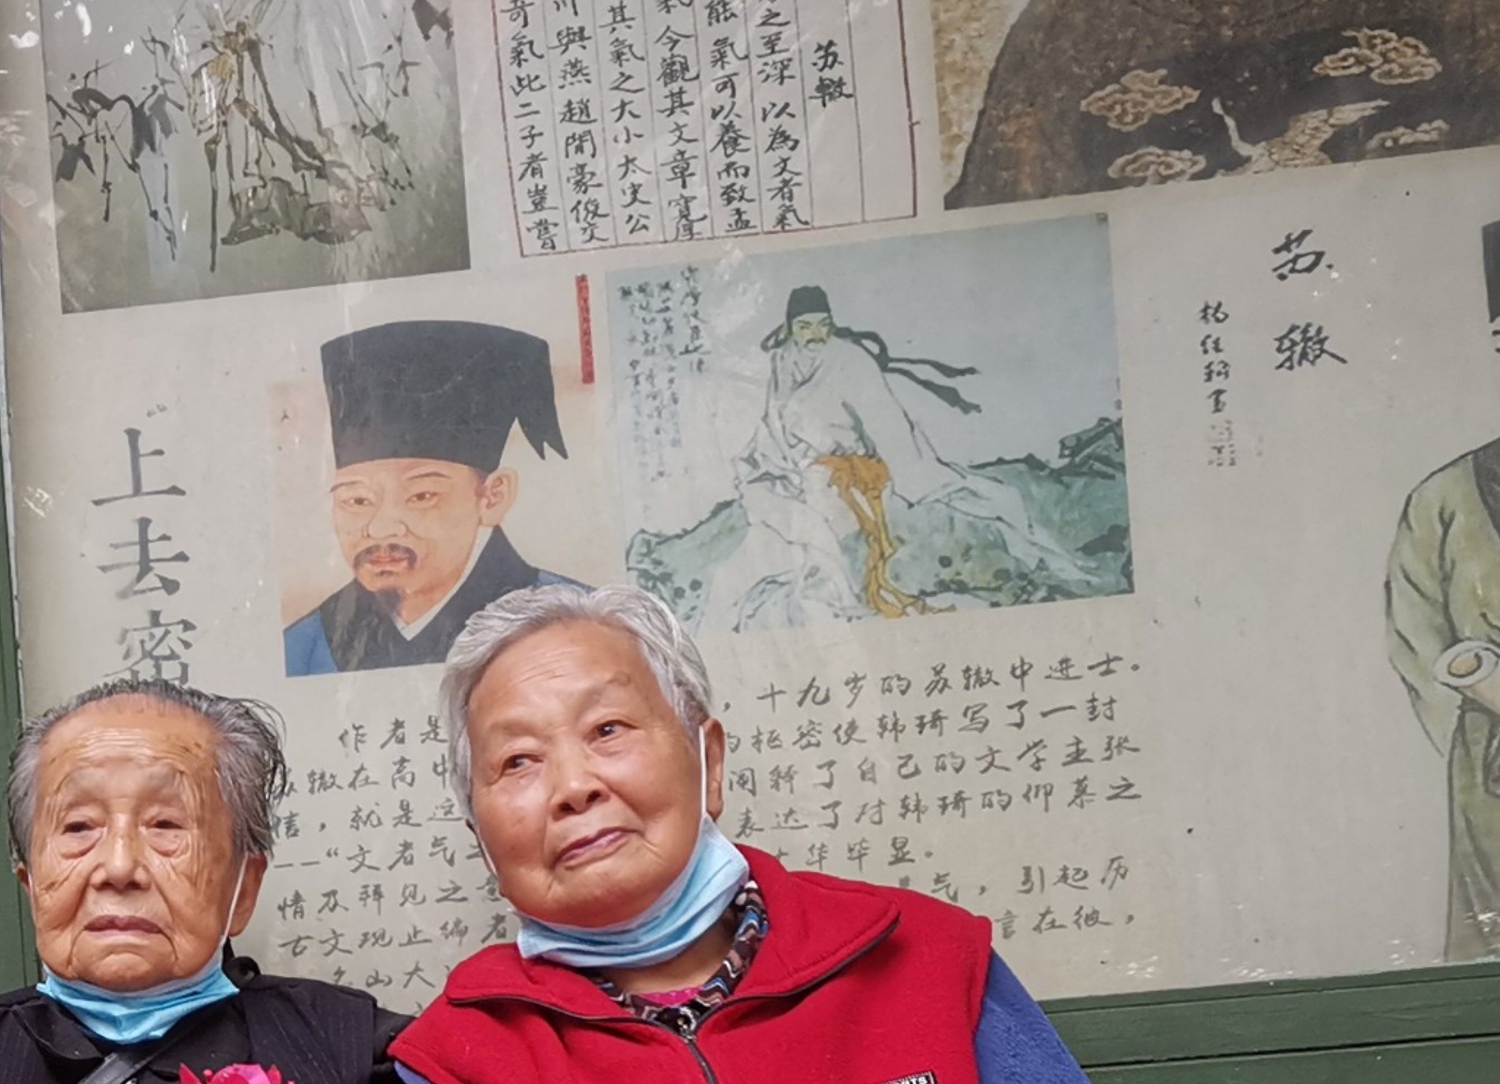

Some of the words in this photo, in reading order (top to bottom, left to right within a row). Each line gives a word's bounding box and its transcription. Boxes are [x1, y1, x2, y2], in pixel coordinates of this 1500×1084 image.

[755, 0, 811, 231] 之至深以為文者氣
[338, 715, 449, 753] 作者是
